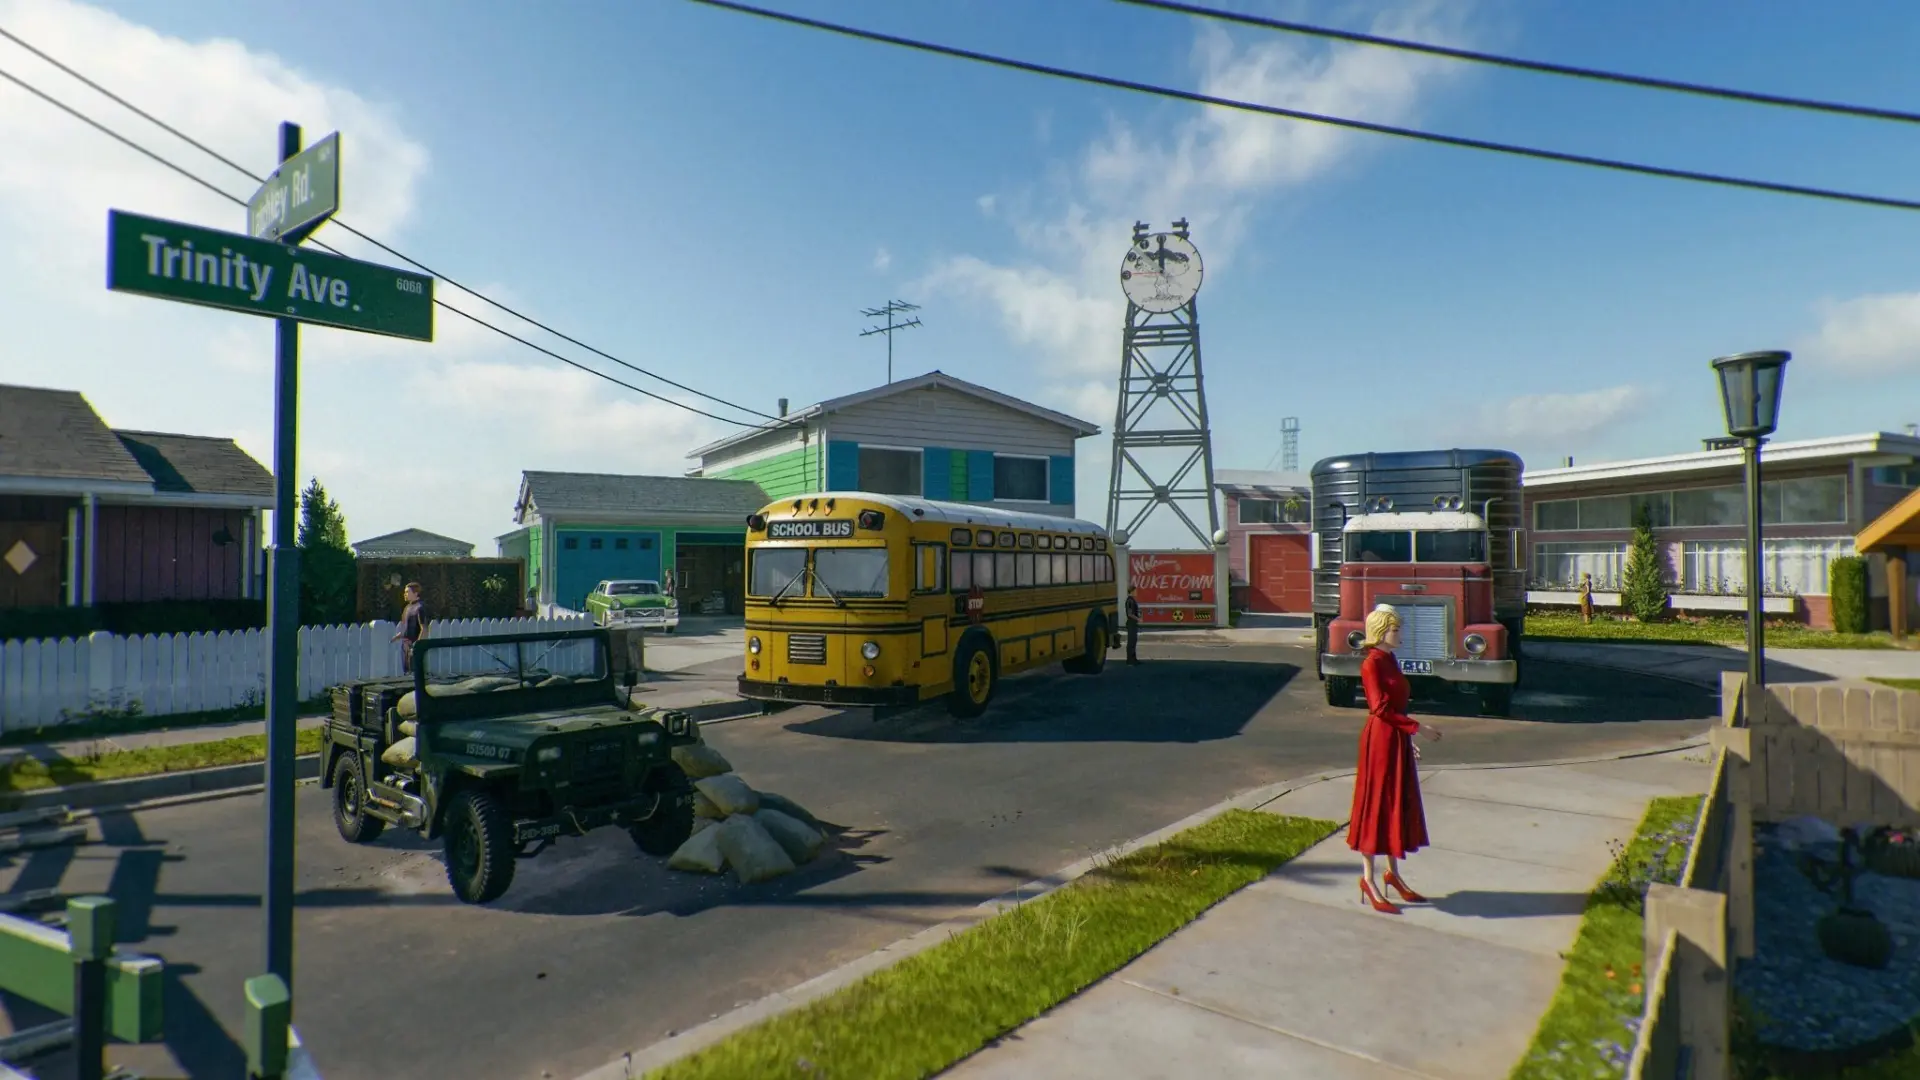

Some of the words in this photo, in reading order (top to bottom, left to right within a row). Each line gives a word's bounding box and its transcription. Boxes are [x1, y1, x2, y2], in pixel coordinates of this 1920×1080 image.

[141, 233, 273, 301] Trinity
[287, 262, 362, 312] Ave.
[772, 523, 820, 536] SCHOOL
[822, 522, 850, 535] BUS
[1131, 574, 1214, 589] NUKETOWN
[967, 598, 984, 610] STOP
